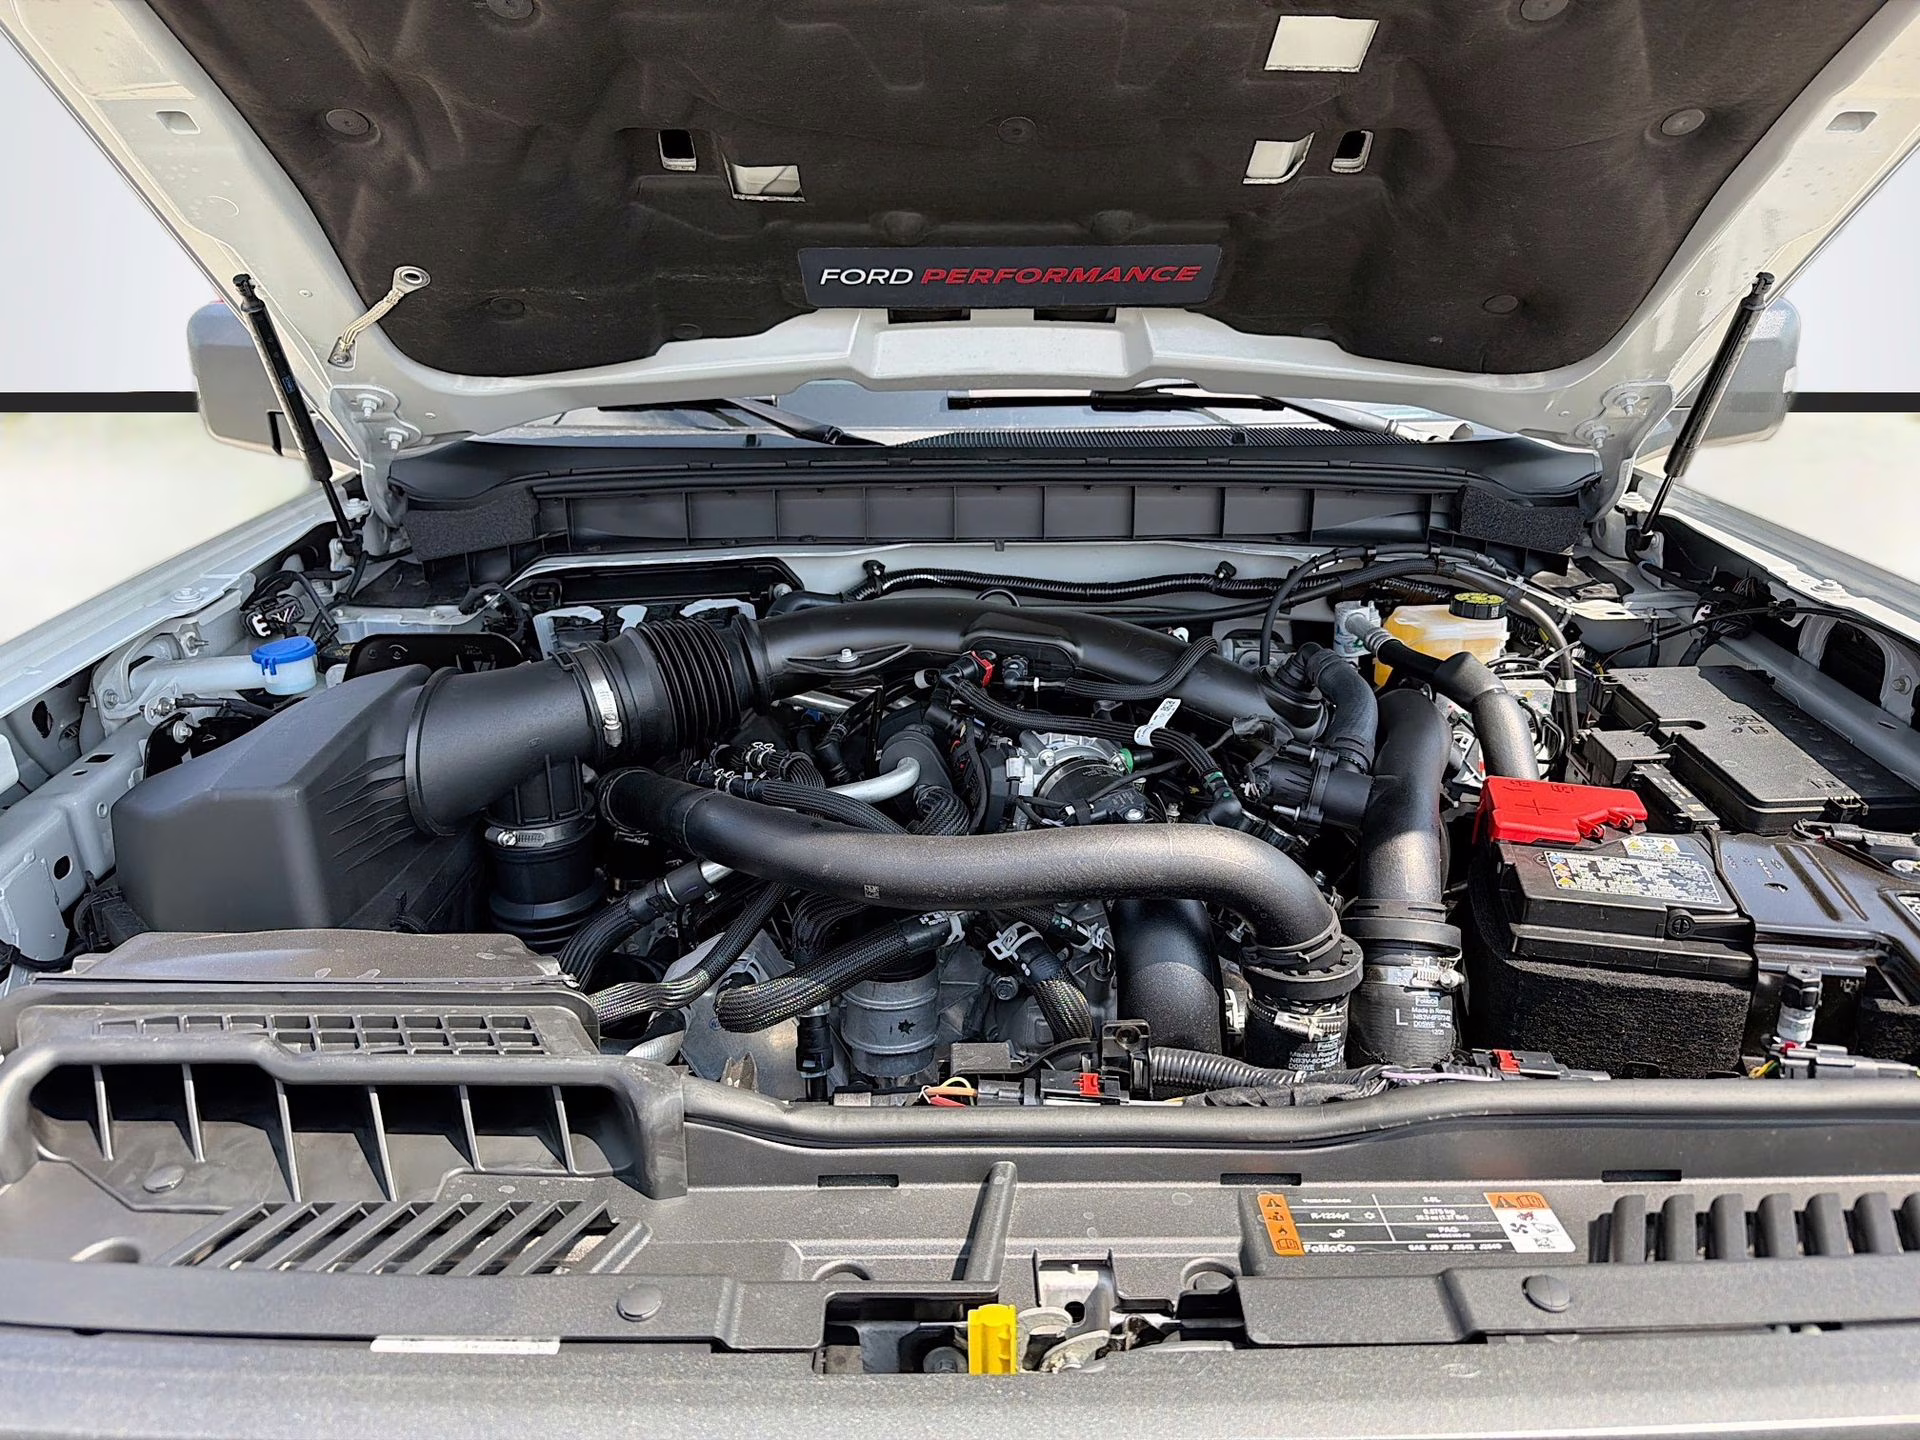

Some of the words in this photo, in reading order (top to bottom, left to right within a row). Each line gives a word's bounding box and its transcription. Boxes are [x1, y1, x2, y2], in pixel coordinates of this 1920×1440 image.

[818, 267, 914, 286] FORD
[919, 264, 1203, 286] PERFORMANCE
[1395, 1008, 1409, 1026] L
[1303, 1244, 1356, 1253] FoMoCo
